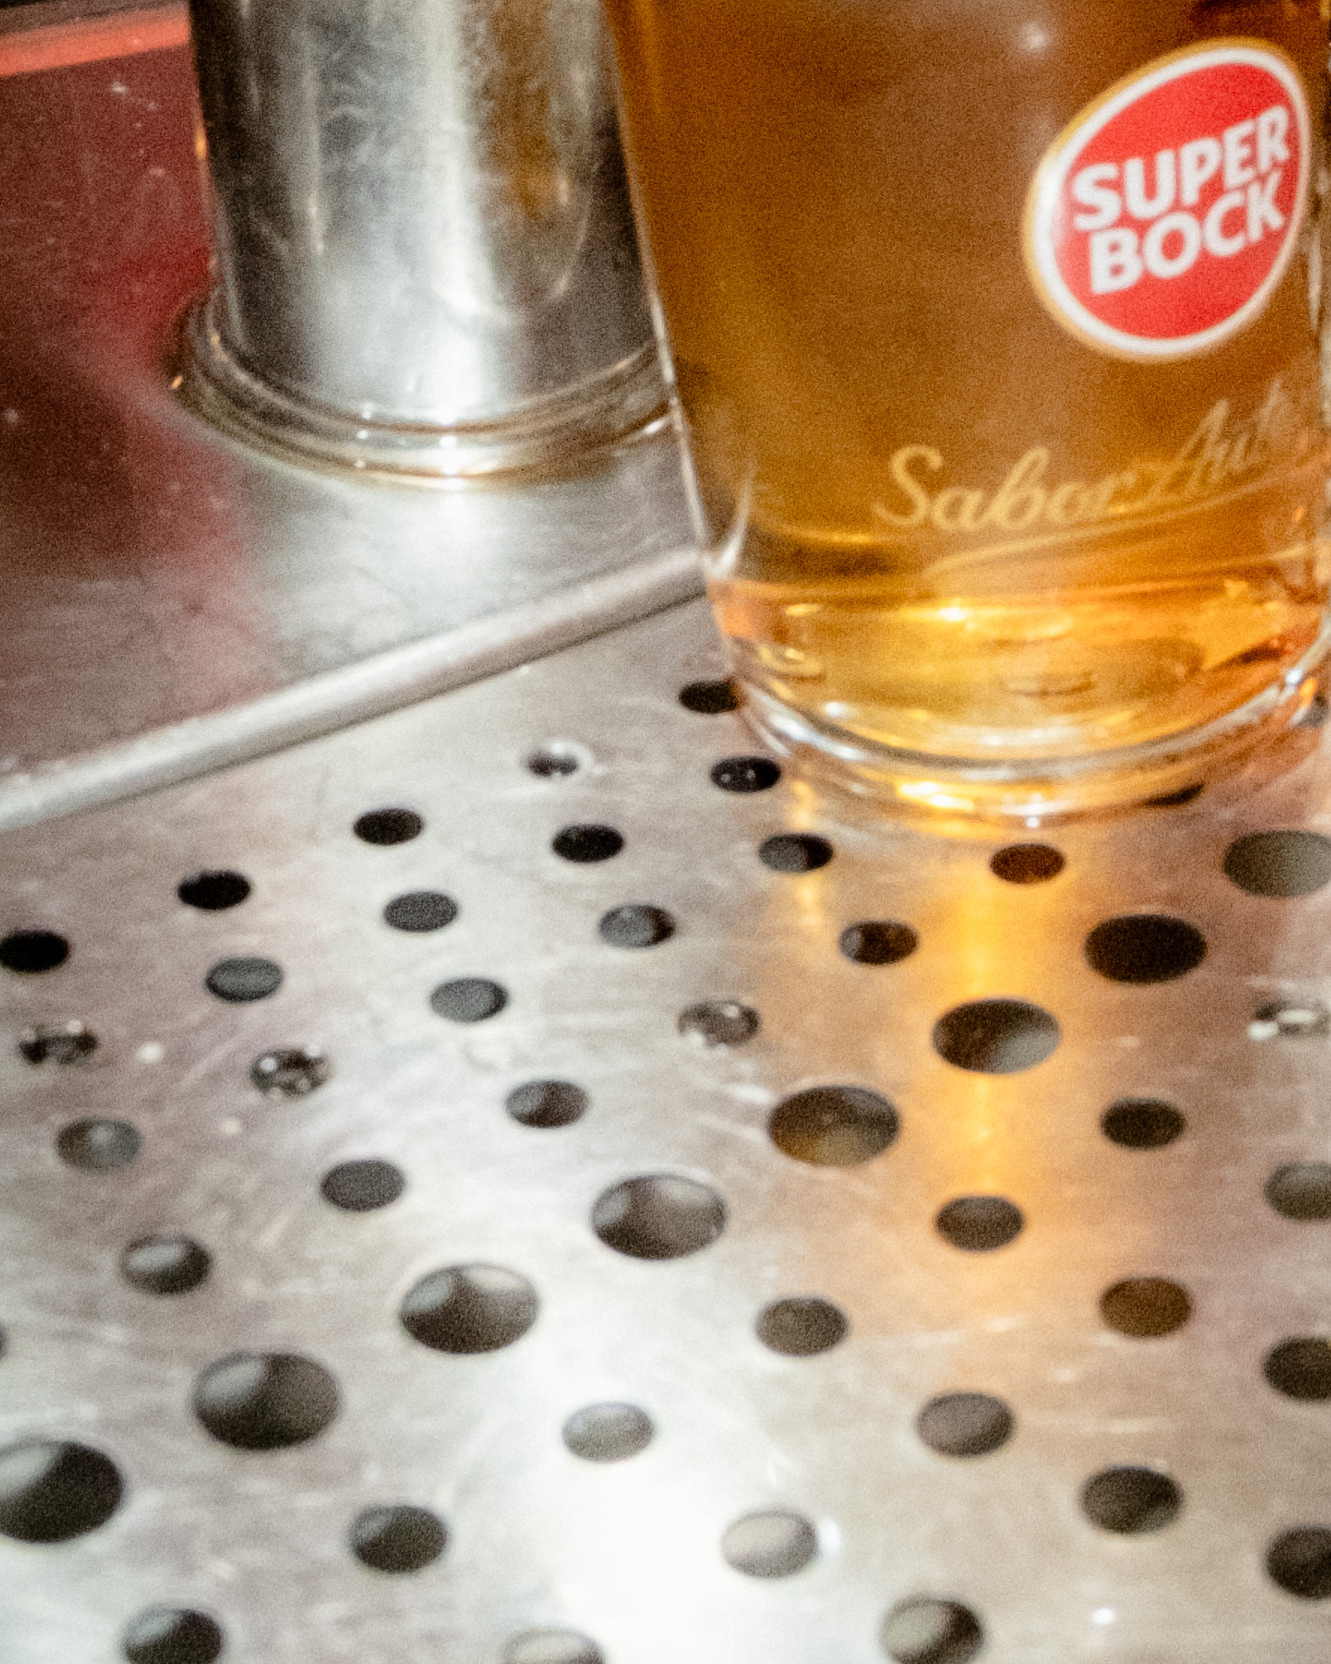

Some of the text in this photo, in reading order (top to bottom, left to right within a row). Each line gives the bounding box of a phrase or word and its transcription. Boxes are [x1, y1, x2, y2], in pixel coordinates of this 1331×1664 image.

[1072, 105, 1291, 232] SUPER
[1088, 171, 1285, 295] BOCK
[872, 444, 1140, 531] Sabor
